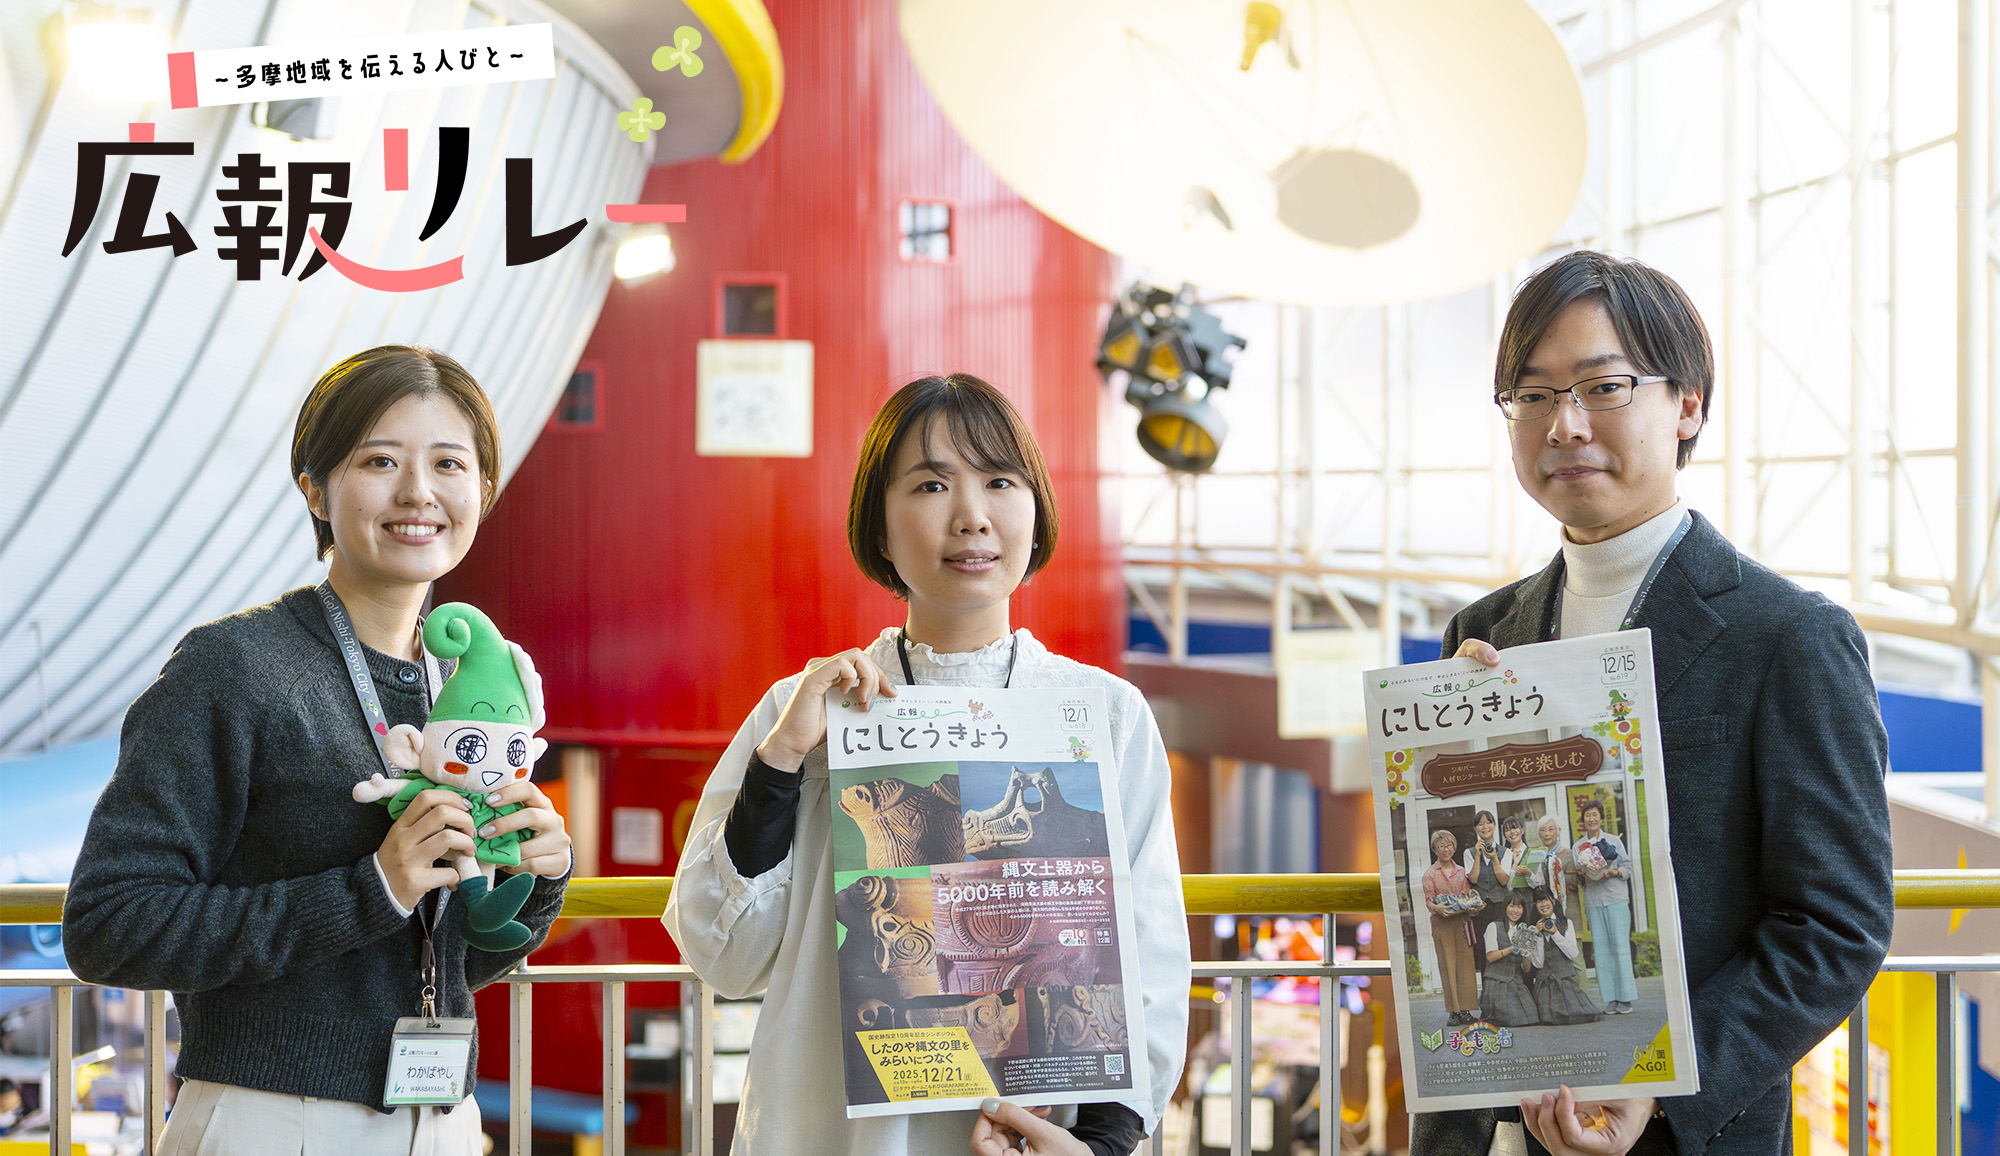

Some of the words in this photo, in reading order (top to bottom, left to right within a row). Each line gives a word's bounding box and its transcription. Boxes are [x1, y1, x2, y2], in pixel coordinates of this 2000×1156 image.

[323, 595, 339, 610] Go!
[330, 611, 361, 670] Nishi-Tokyo
[1602, 654, 1635, 674] 12/15
[356, 672, 369, 693] City
[1432, 683, 1453, 694] 広報
[897, 708, 918, 716] 広報
[1062, 707, 1088, 722] 12/1
[1381, 686, 1544, 737] にしとうきょう
[842, 721, 1009, 755] にしとうきょう
[1489, 751, 1586, 779] 働くを楽しむ
[1001, 859, 1106, 878] 縄文土器から
[937, 879, 1107, 905] 5000年前を読み解く
[871, 1039, 970, 1055] したのや縄文の里を
[1446, 1027, 1513, 1056] 子ども記者
[879, 1052, 954, 1067] みらいにつなぐ
[406, 1066, 454, 1079] わかばやし
